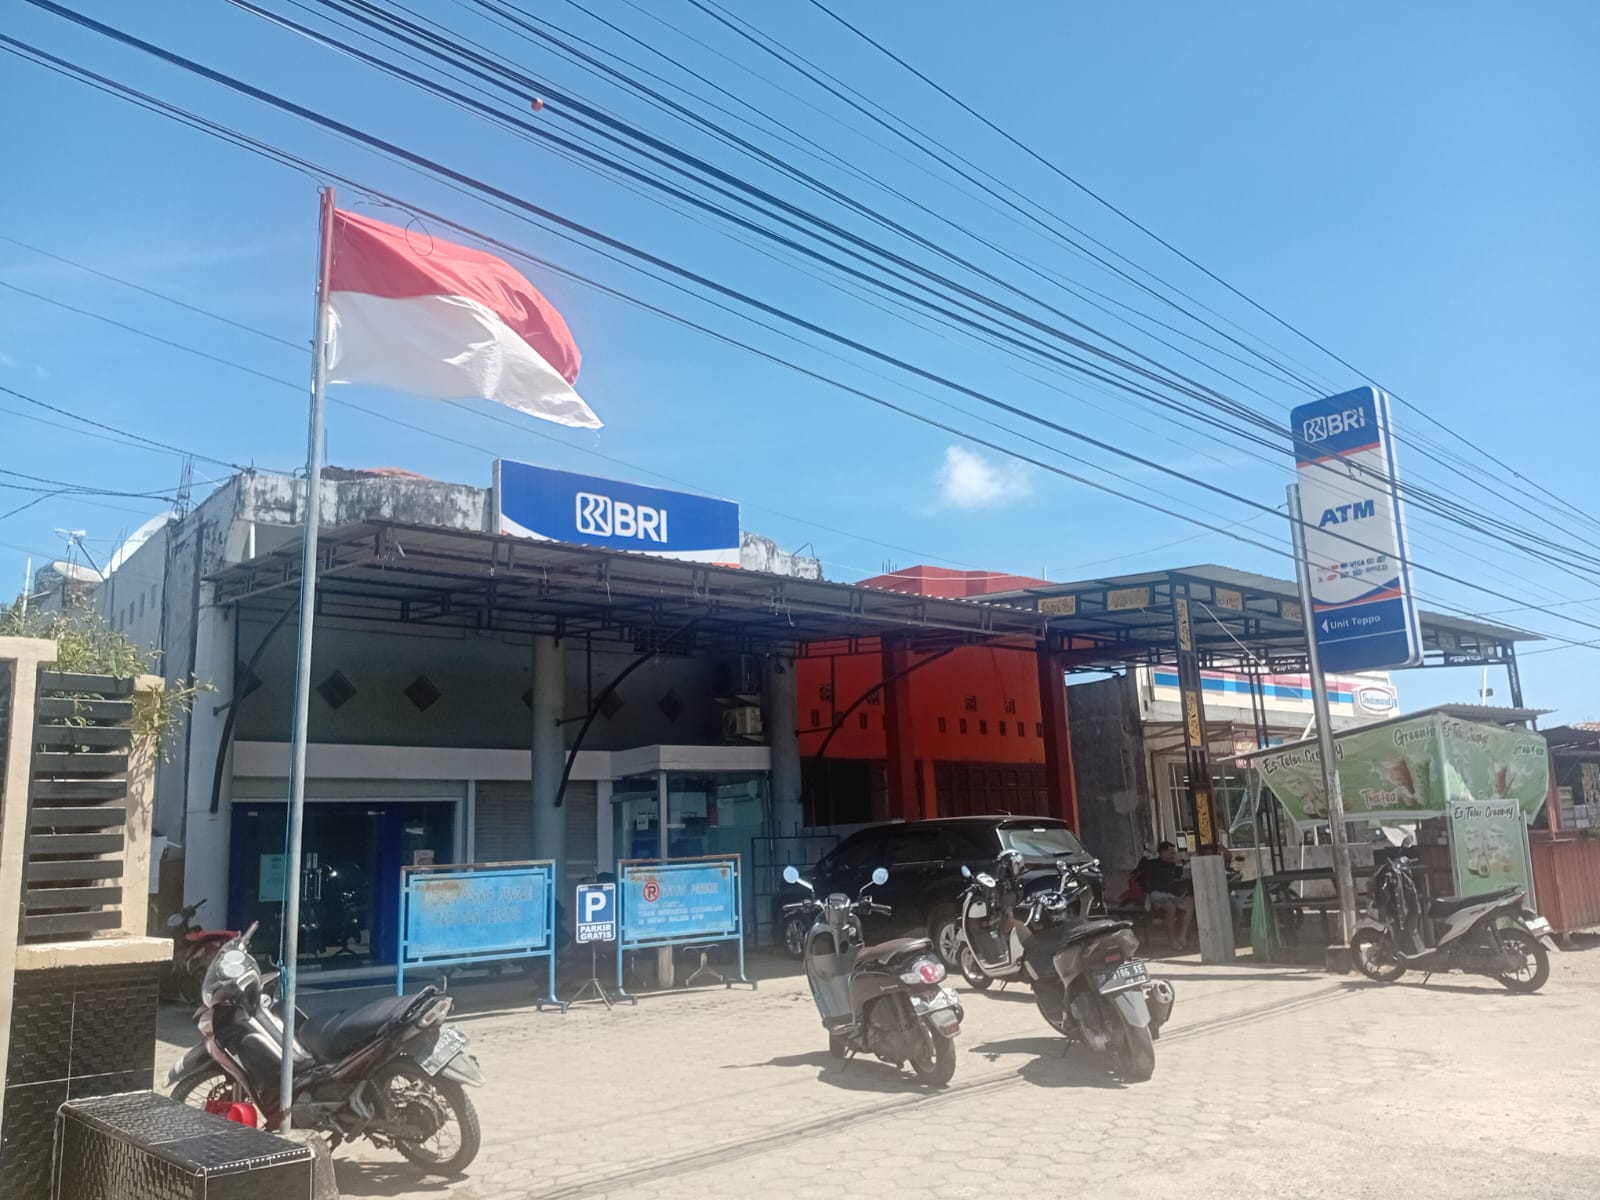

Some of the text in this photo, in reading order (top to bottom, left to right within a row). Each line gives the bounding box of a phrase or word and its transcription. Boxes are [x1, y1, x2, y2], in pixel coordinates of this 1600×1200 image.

[1328, 407, 1366, 435] BRI
[614, 502, 668, 543] BRI
[1318, 499, 1375, 528] ATM
[1349, 559, 1365, 568] VISA
[1330, 615, 1381, 630] Unit Teppo
[1262, 757, 1278, 774] Es
[1304, 743, 1344, 763] Crey
[1454, 807, 1464, 819] Es
[585, 891, 607, 922] P
[579, 924, 612, 933] PARKIR
[580, 931, 612, 941] GRATIS
